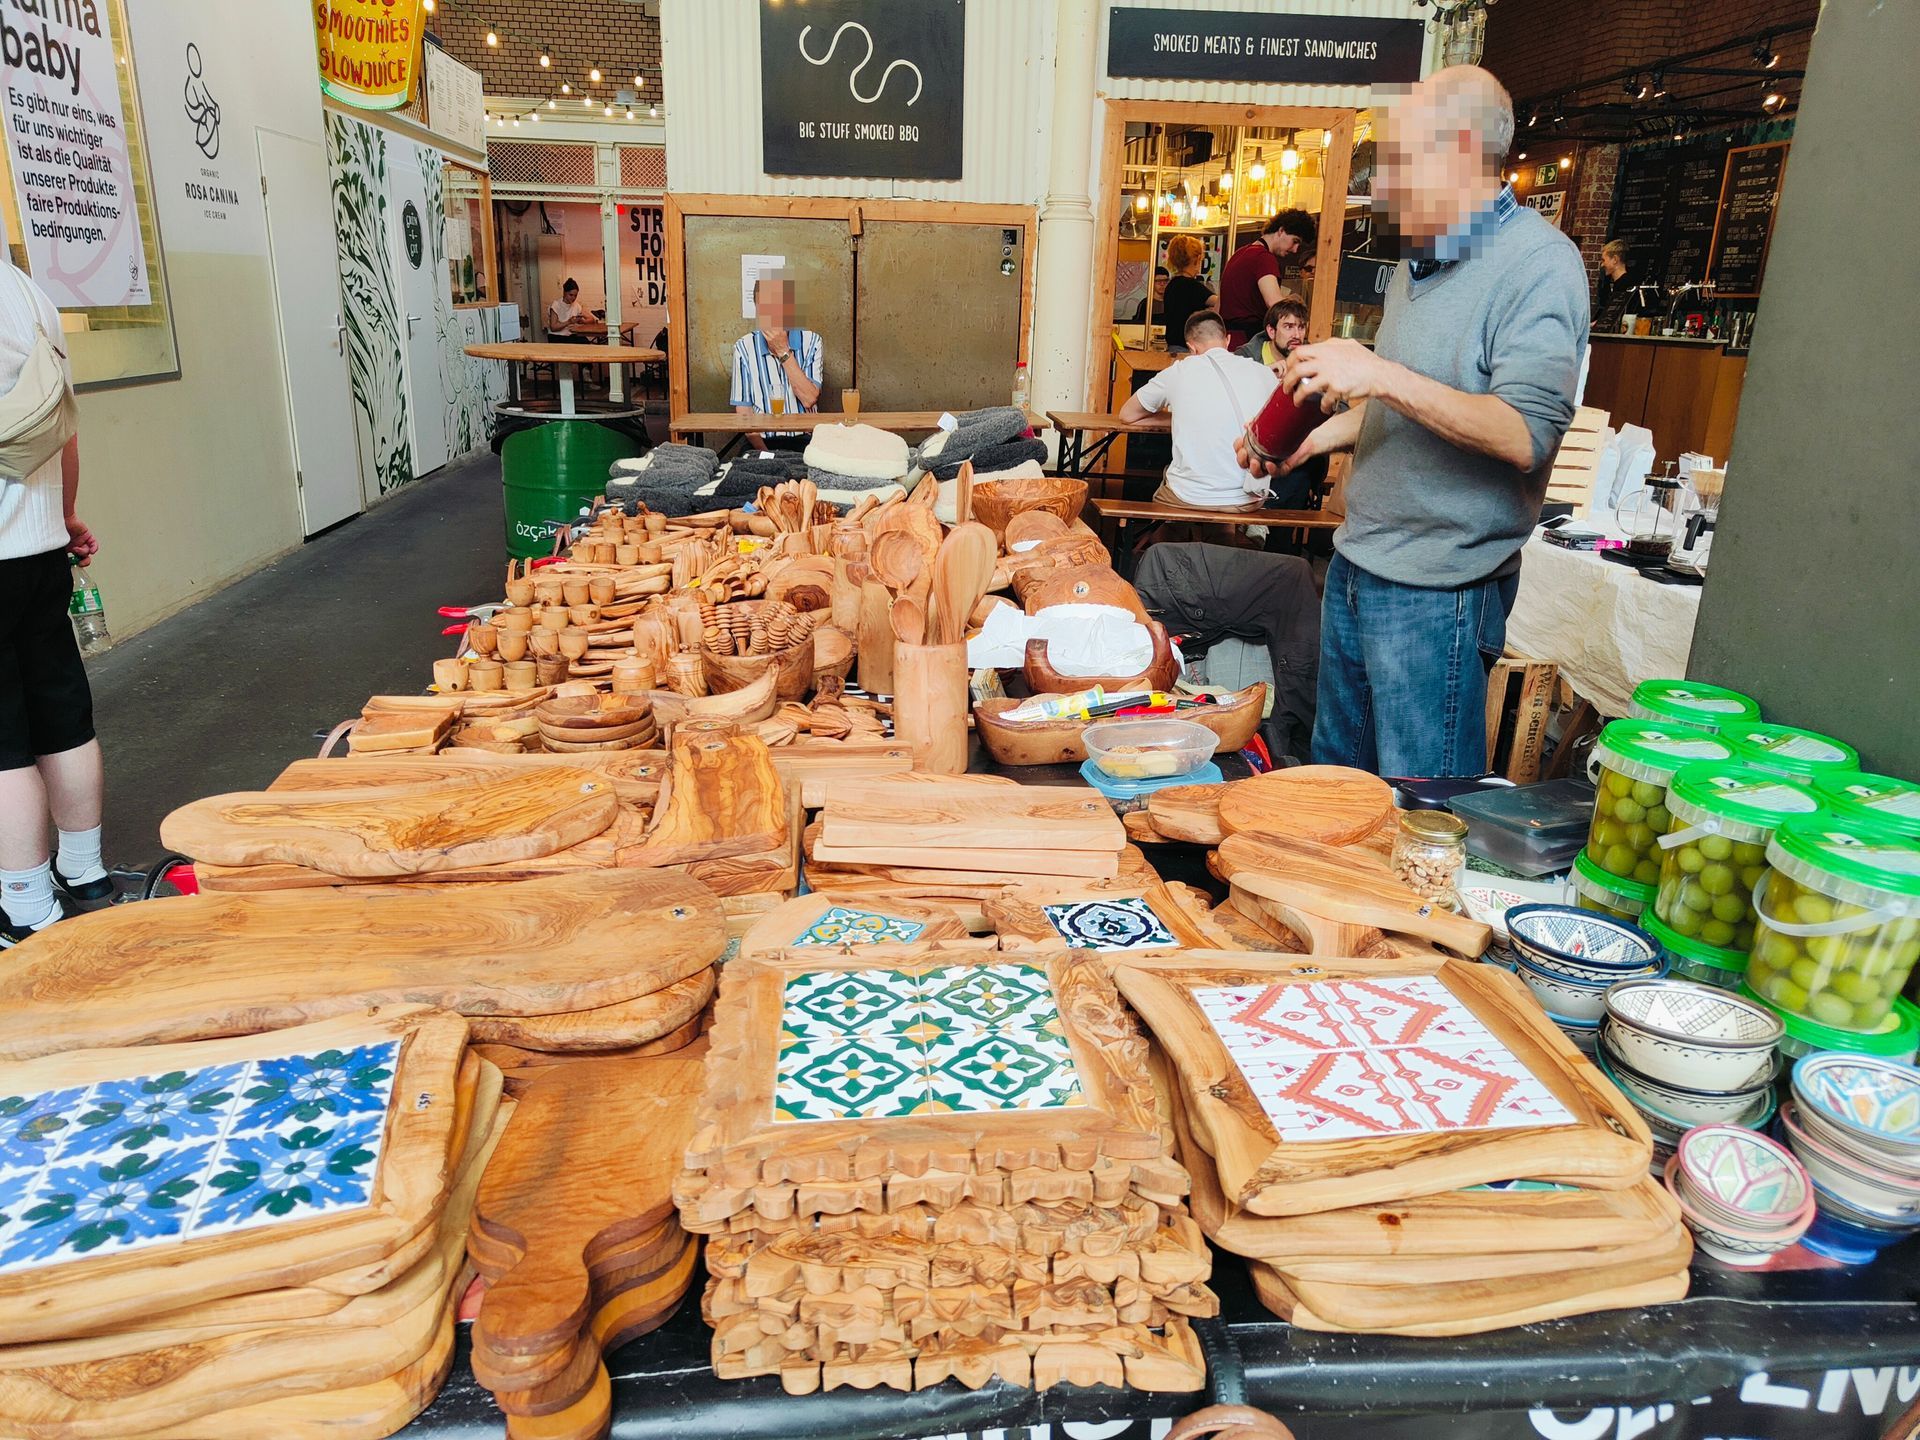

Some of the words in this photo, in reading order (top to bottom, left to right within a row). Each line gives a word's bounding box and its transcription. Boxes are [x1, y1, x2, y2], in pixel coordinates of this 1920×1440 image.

[318, 3, 409, 44] SMOOTHIES
[0, 9, 81, 95] baby
[1153, 33, 1199, 53] SMOKED
[1204, 35, 1241, 55] MEATS
[1245, 37, 1255, 55] &
[1260, 37, 1300, 56] FINEST
[1304, 39, 1377, 60] SANDWICHES
[8, 86, 25, 107] Es
[26, 92, 50, 114] gibt
[52, 99, 69, 117] nur
[72, 103, 96, 126] eins,
[96, 112, 116, 128] was
[13, 114, 30, 134] für
[33, 121, 54, 139] uns
[55, 124, 103, 151] wichtiger
[799, 121, 815, 138] BIG
[820, 122, 850, 139] STUFF
[854, 123, 895, 141] SMOKED
[899, 125, 919, 142] BBQ
[17, 140, 34, 160] ist
[35, 144, 52, 163] als
[54, 147, 71, 166] die
[73, 150, 113, 173] Qualität
[22, 171, 66, 190] unserer
[68, 173, 118, 196] Produkte:
[184, 182, 208, 201] ROSA
[209, 186, 240, 206] CANINA
[27, 192, 54, 213] faire
[55, 196, 121, 220] Produktions-
[31, 219, 107, 244] bedingungen.
[640, 232, 666, 257] FO
